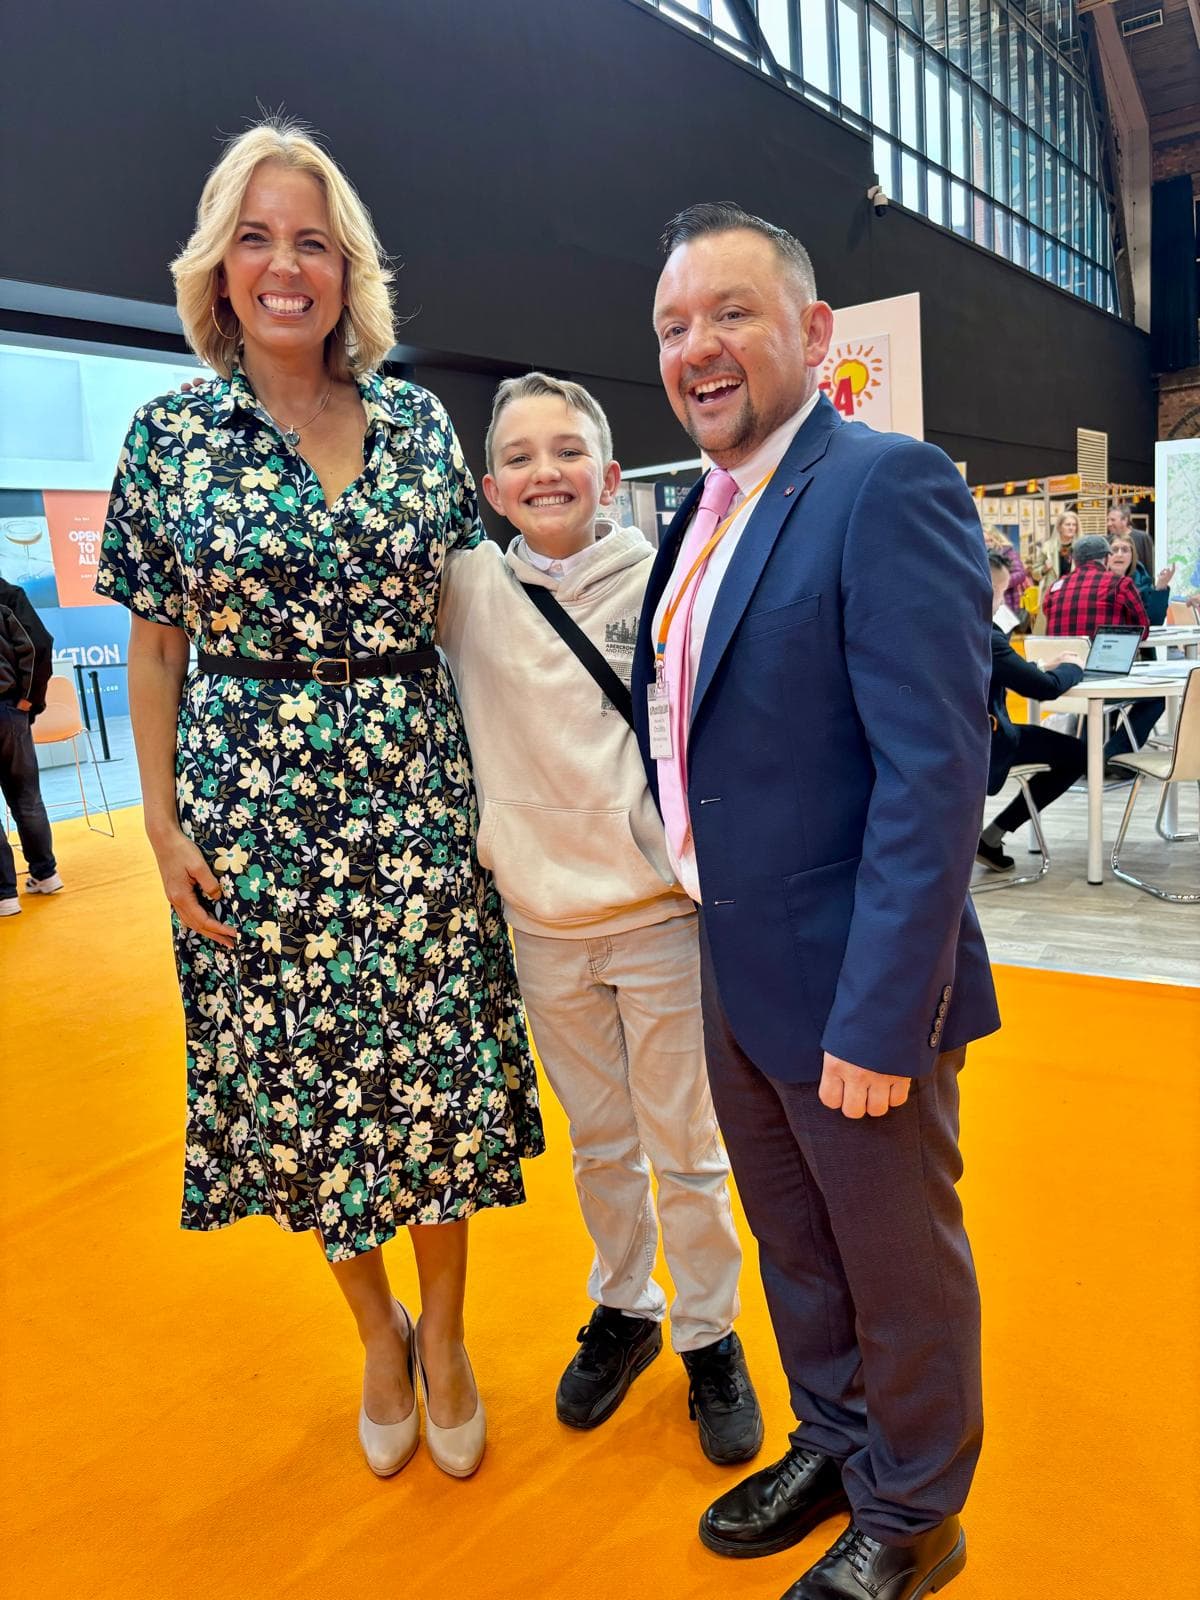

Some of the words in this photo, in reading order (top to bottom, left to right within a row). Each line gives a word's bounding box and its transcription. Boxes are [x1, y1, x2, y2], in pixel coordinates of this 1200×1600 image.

[68, 530, 101, 542] OPEN
[78, 542, 95, 554] TO
[79, 553, 98, 565] ALL
